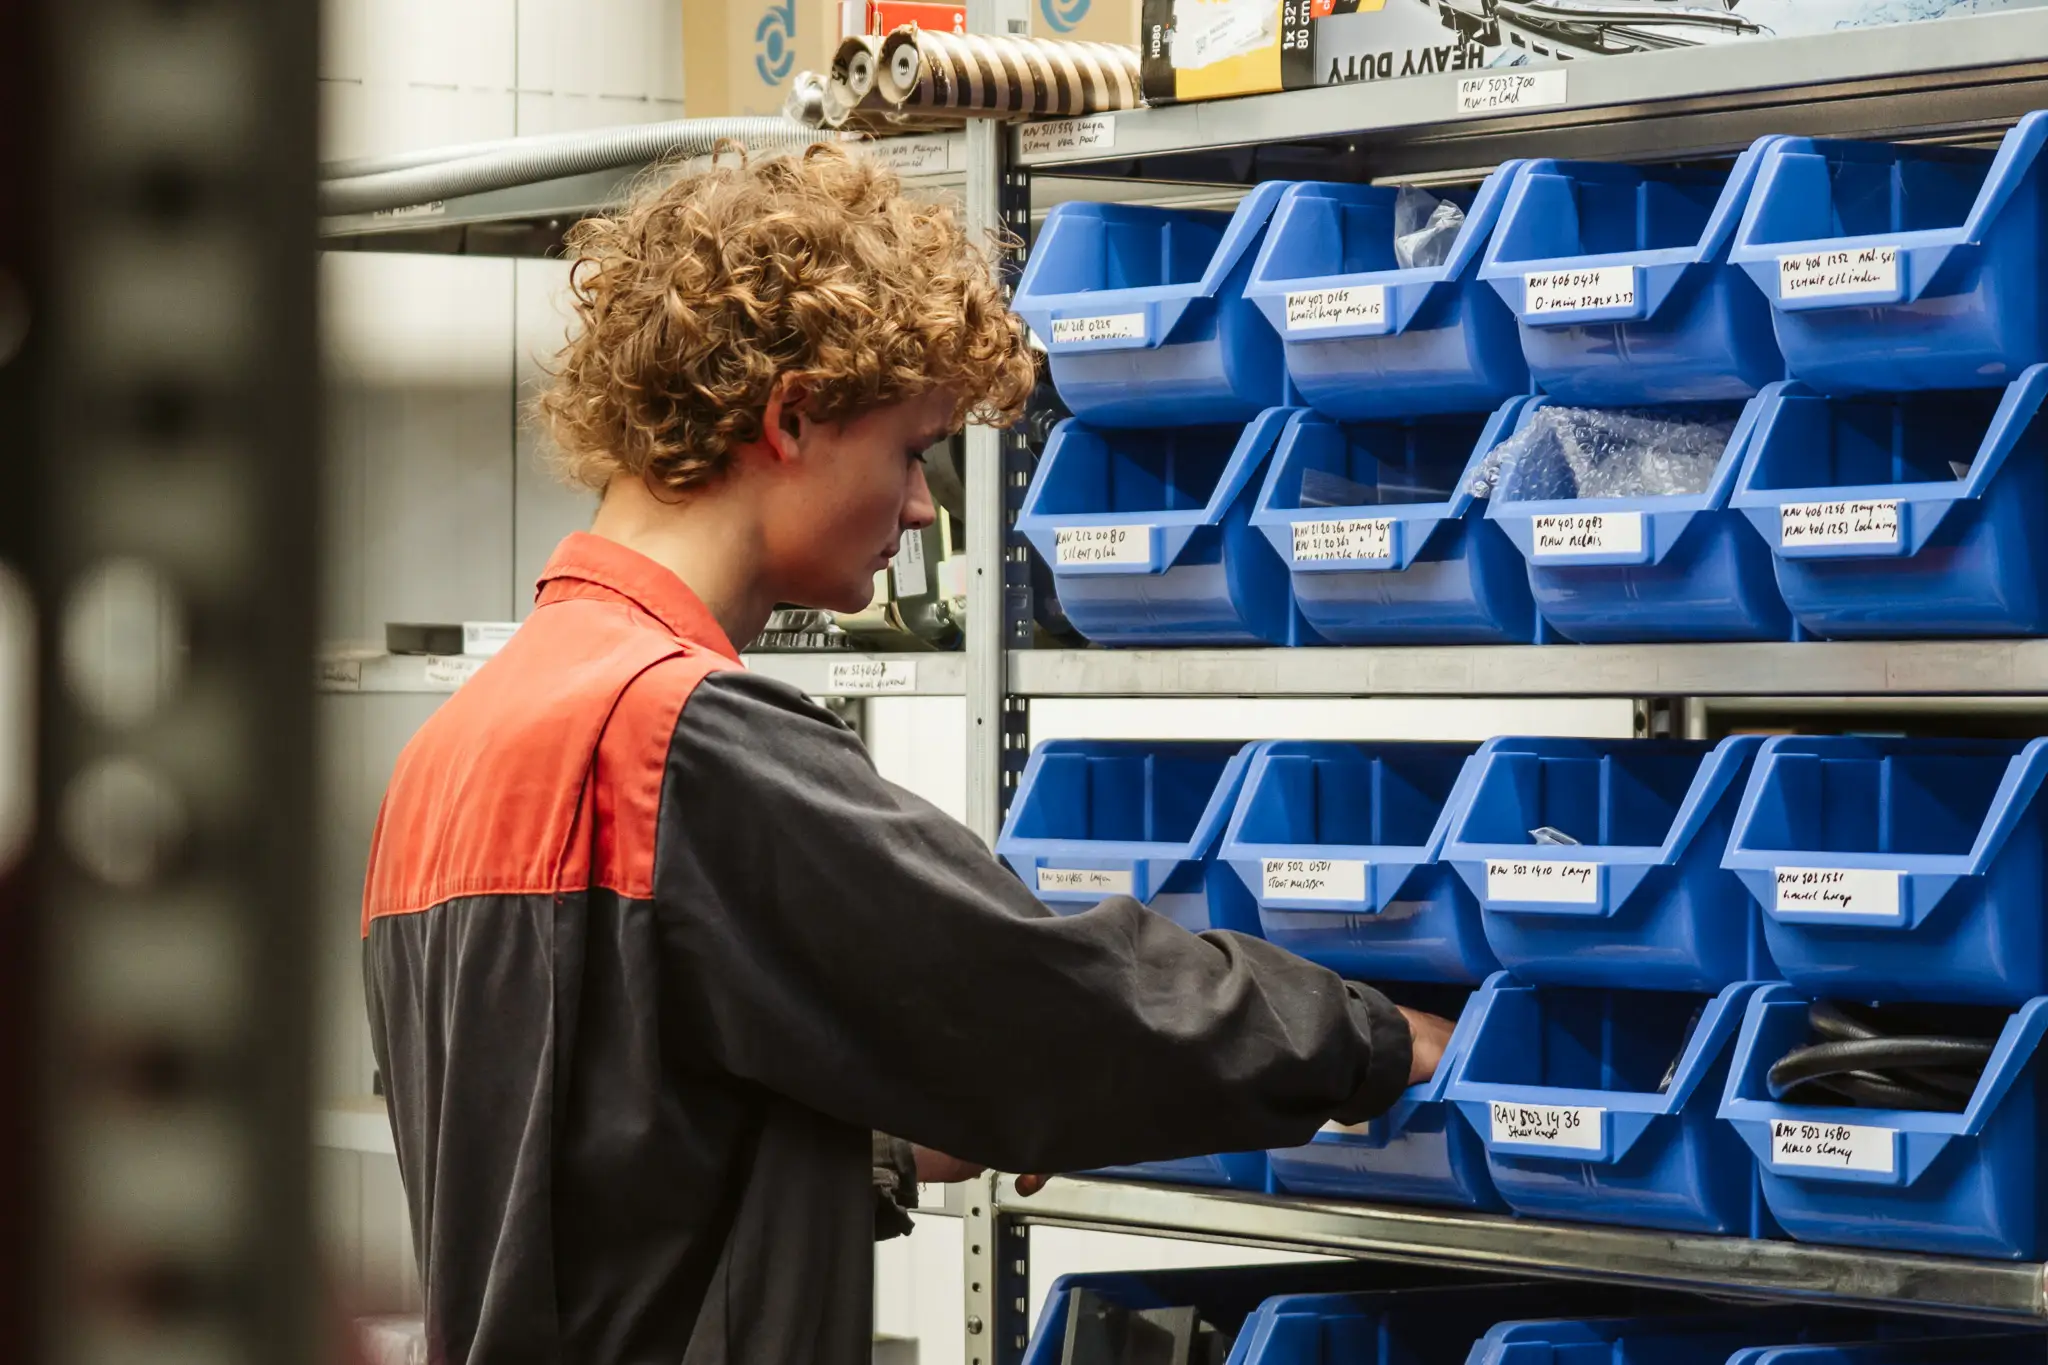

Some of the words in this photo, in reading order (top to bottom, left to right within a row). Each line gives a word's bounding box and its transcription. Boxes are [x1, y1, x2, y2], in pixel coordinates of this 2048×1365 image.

[1152, 24, 1161, 58] HD80
[1297, 29, 1309, 49] 80
[1328, 52, 1393, 84] DUTY
[1400, 44, 1484, 77] HEAVY
[1782, 261, 1801, 272] RAV
[1806, 255, 1821, 271] 406
[1827, 252, 1849, 267] 1252
[1529, 277, 1549, 288] RAV
[1552, 273, 1571, 289] 406
[1573, 272, 1601, 288] 0434
[1288, 297, 1306, 308] RAV
[1308, 294, 1323, 308] 403
[1327, 290, 1350, 305] 0165
[1782, 507, 1802, 518] RAV
[1806, 504, 1822, 518] 406
[1536, 518, 1555, 529] RAV
[1557, 517, 1574, 531] 403
[1785, 525, 1806, 538] RAV
[1809, 522, 1825, 536] 406
[1056, 532, 1073, 546] RAV
[1075, 530, 1092, 542] 212
[1096, 528, 1126, 544] 0080
[1266, 861, 1284, 872] RAV
[1287, 861, 1304, 872] 502
[1309, 861, 1332, 872] 0501
[1513, 864, 1527, 875] 503
[1531, 864, 1553, 877] 1410
[1778, 873, 1799, 883] RAV
[1802, 872, 1818, 885] 503
[1494, 1104, 1516, 1123] RAV
[1775, 1122, 1798, 1137] RAV
[1801, 1125, 1820, 1139] 503
[1824, 1126, 1851, 1141] 1580
